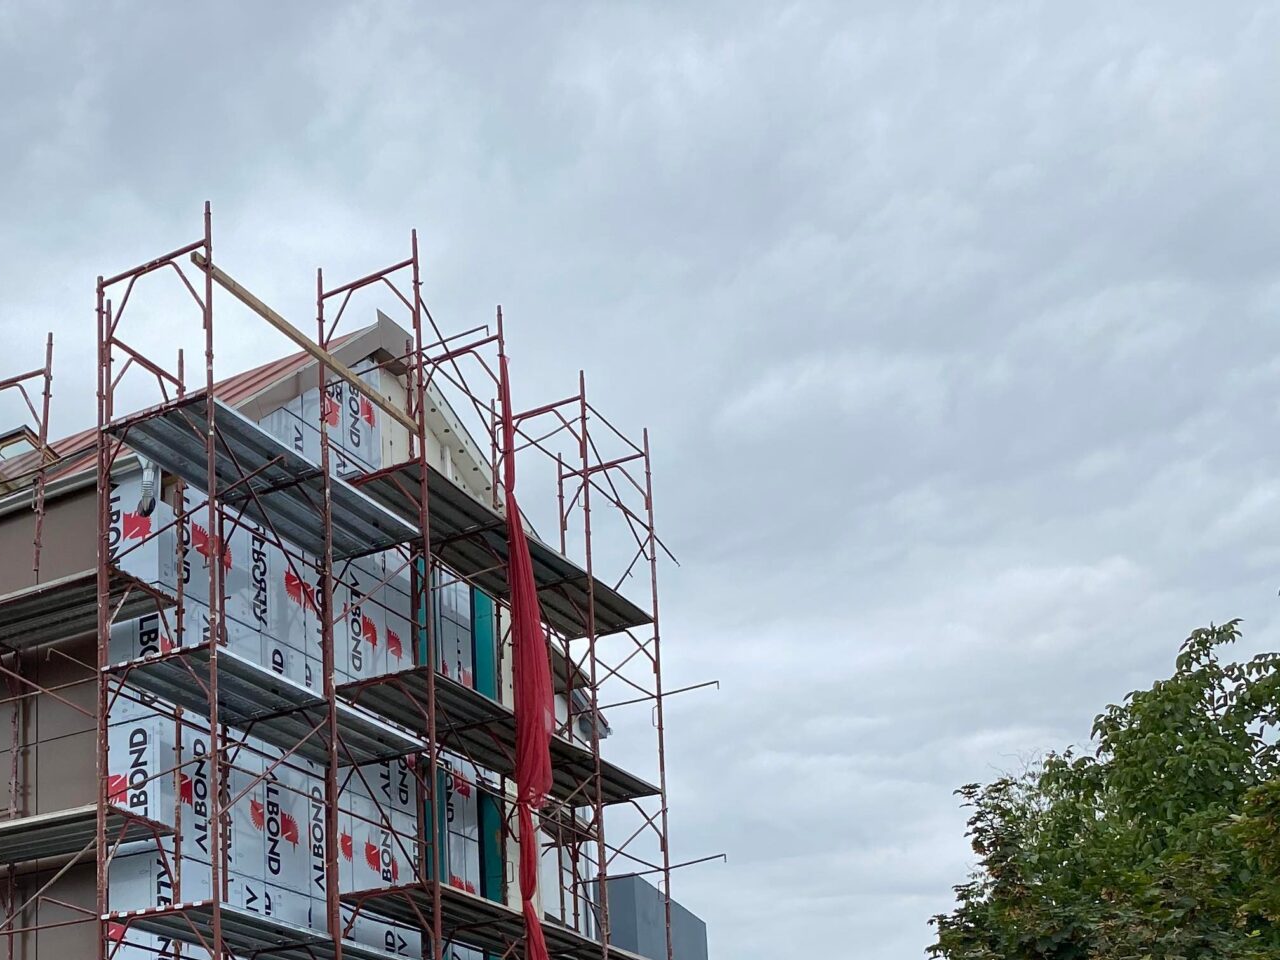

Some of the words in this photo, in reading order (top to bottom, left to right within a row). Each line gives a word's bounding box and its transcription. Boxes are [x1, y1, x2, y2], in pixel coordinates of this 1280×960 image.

[349, 383, 361, 448] BOND
[129, 727, 148, 816] BOND
[193, 738, 208, 855] ALBOND
[266, 766, 281, 876] ALBOND
[312, 786, 325, 892] ALBOND
[381, 813, 393, 883] BOND
